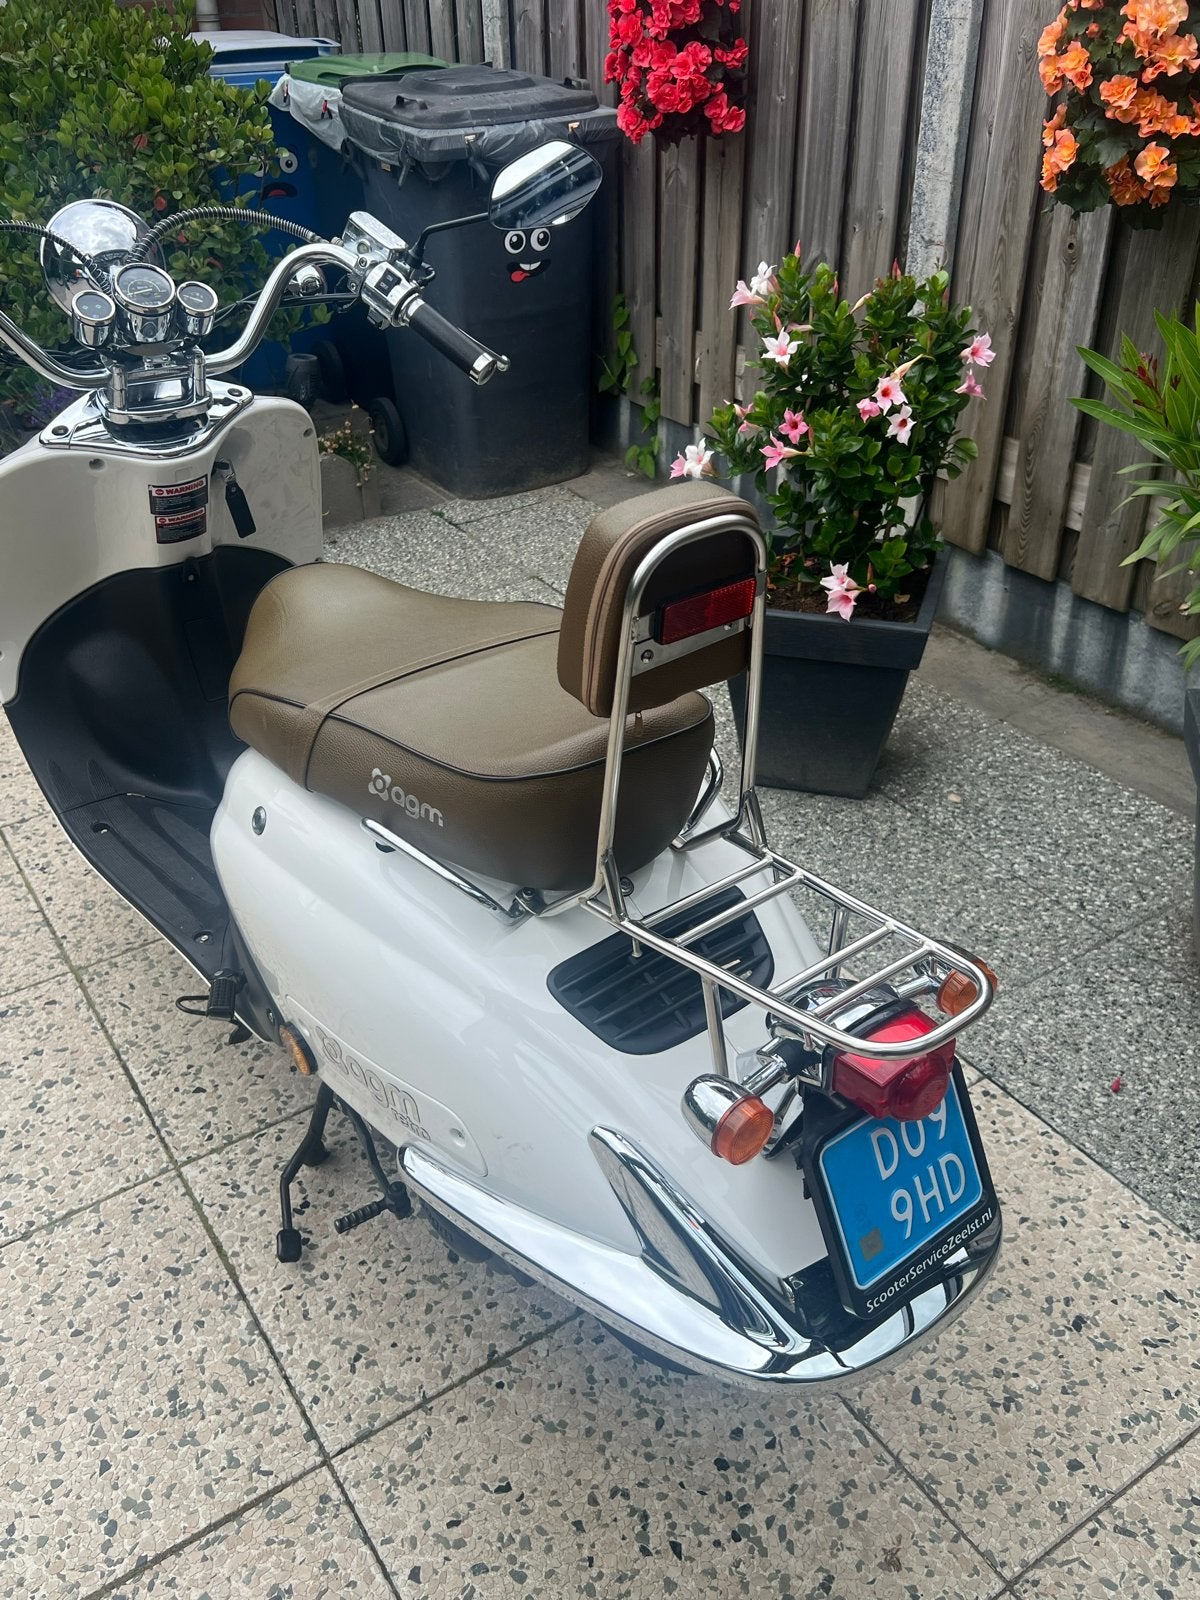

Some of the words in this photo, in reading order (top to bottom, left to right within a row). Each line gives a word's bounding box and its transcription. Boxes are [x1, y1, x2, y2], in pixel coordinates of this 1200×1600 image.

[165, 480, 204, 495] WARNING
[391, 786, 443, 827] agm
[891, 1152, 966, 1240] 9HD
[866, 1207, 993, 1313] ScooterServiceZeelst.nl
